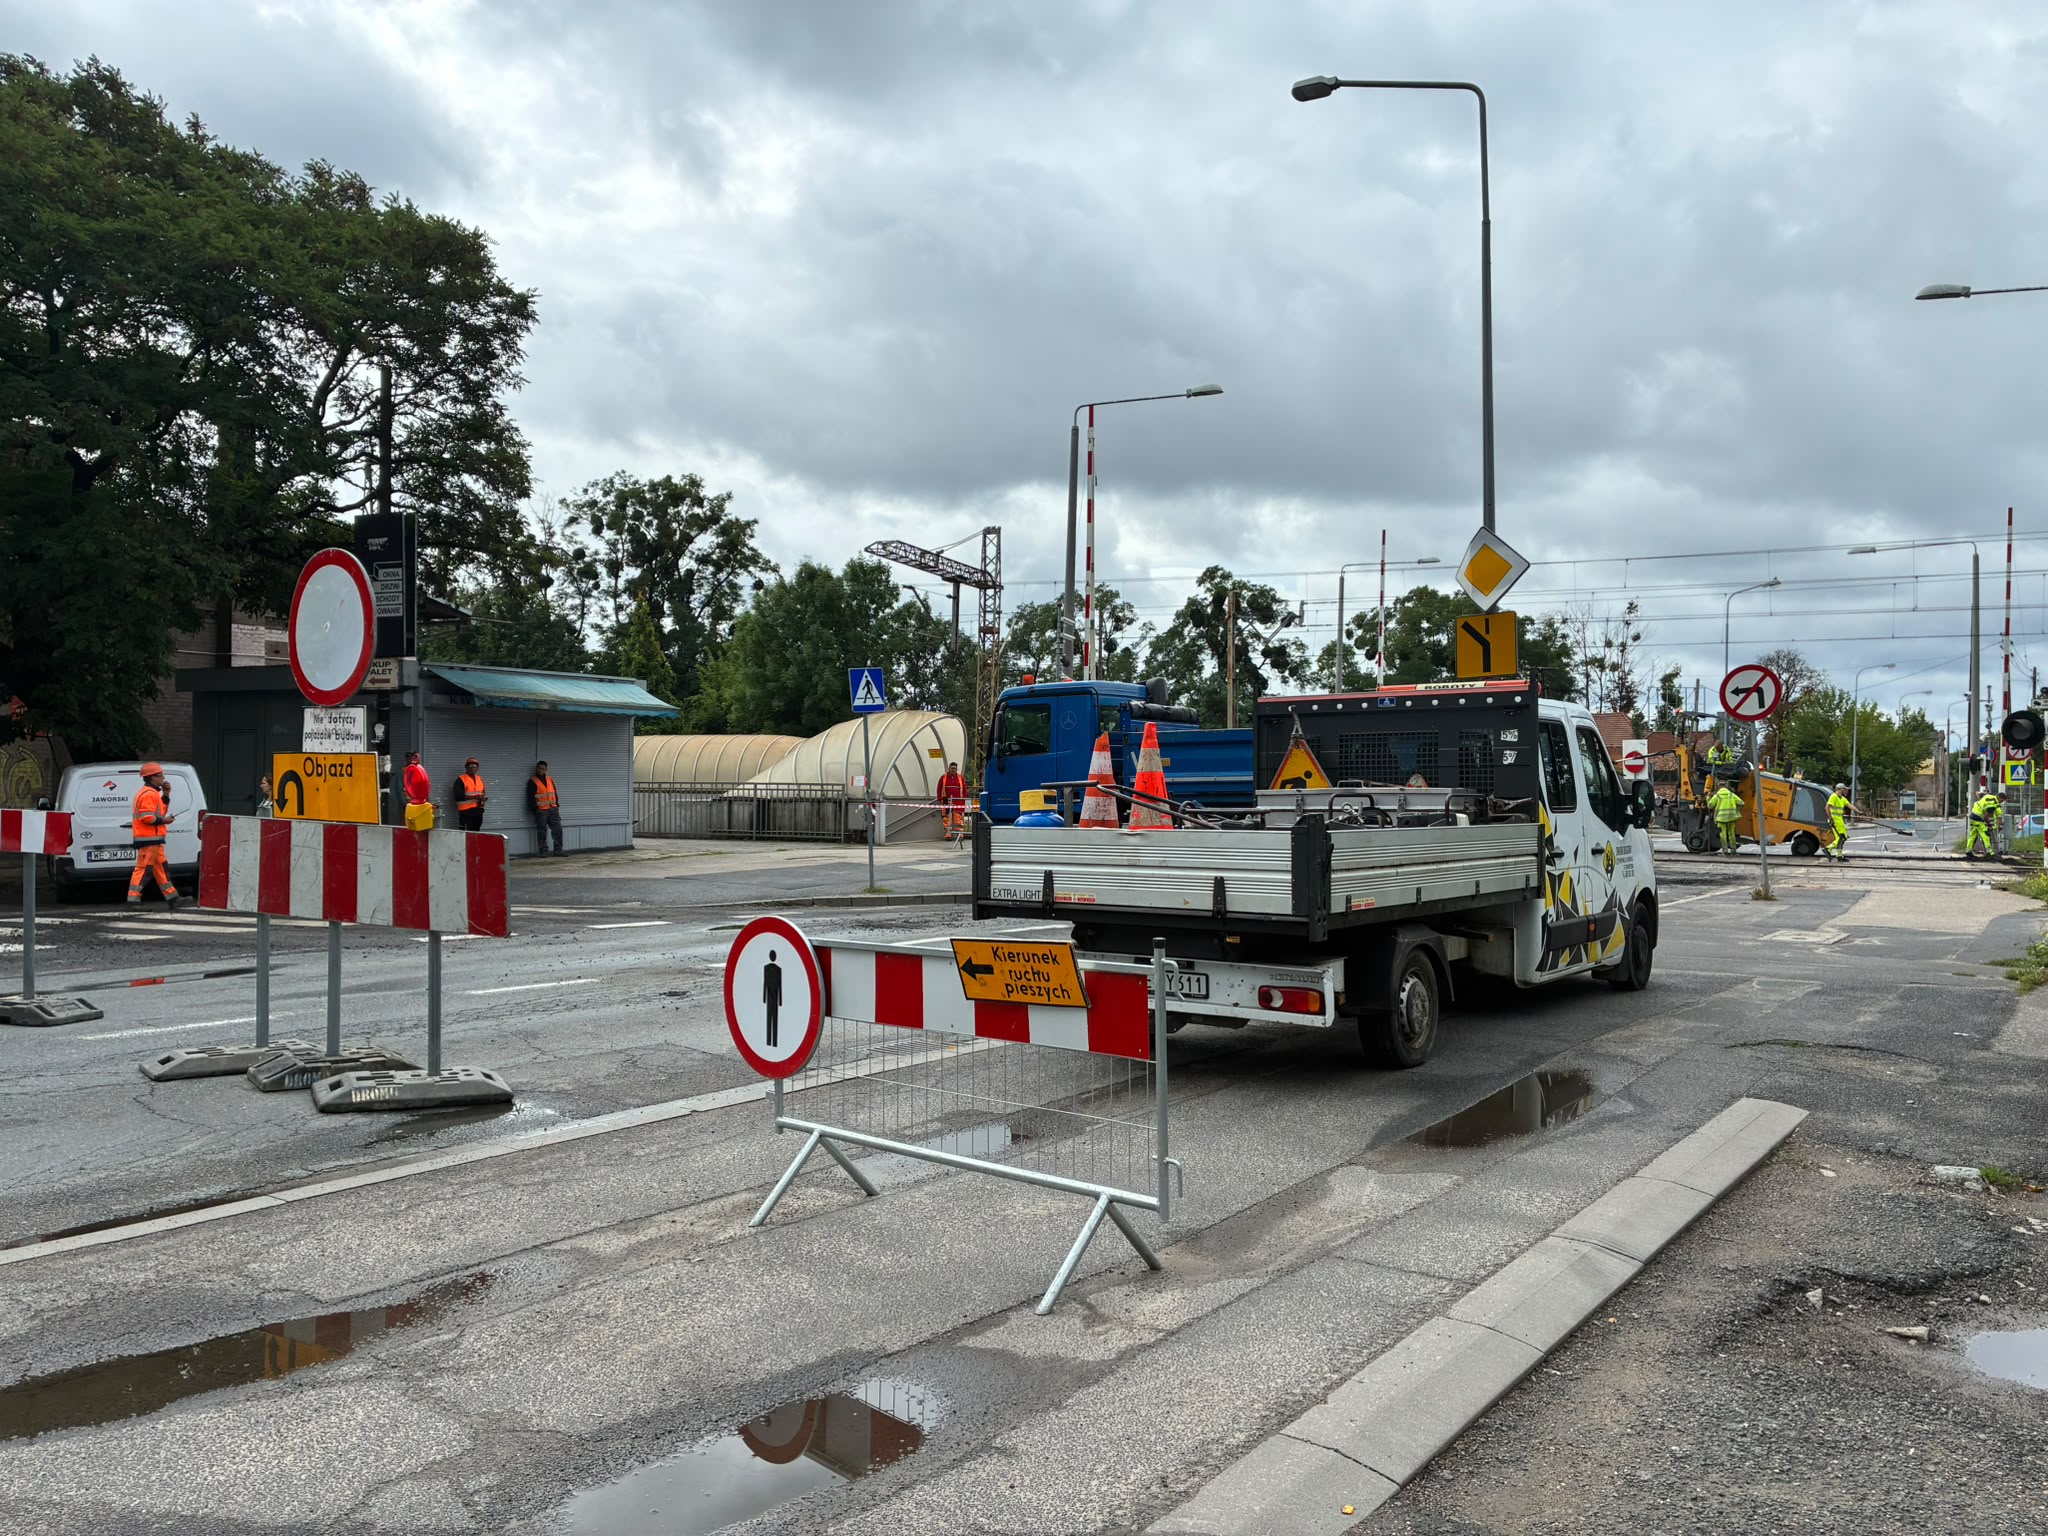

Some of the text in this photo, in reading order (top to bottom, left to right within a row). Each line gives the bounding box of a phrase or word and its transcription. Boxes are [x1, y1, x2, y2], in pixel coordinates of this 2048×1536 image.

[380, 583, 401, 591] DRZWI
[376, 607, 401, 616] OWANIE
[372, 660, 391, 668] KUP
[369, 668, 393, 676] ALET
[328, 711, 357, 727] dotyczy
[303, 756, 353, 783] Objazd
[992, 887, 1041, 900] EXTRA LIGHT
[991, 946, 1060, 966] Kierunek
[1008, 966, 1051, 983] ruchu
[1004, 982, 1072, 1002] pieszych
[352, 1087, 398, 1102] DROMO
